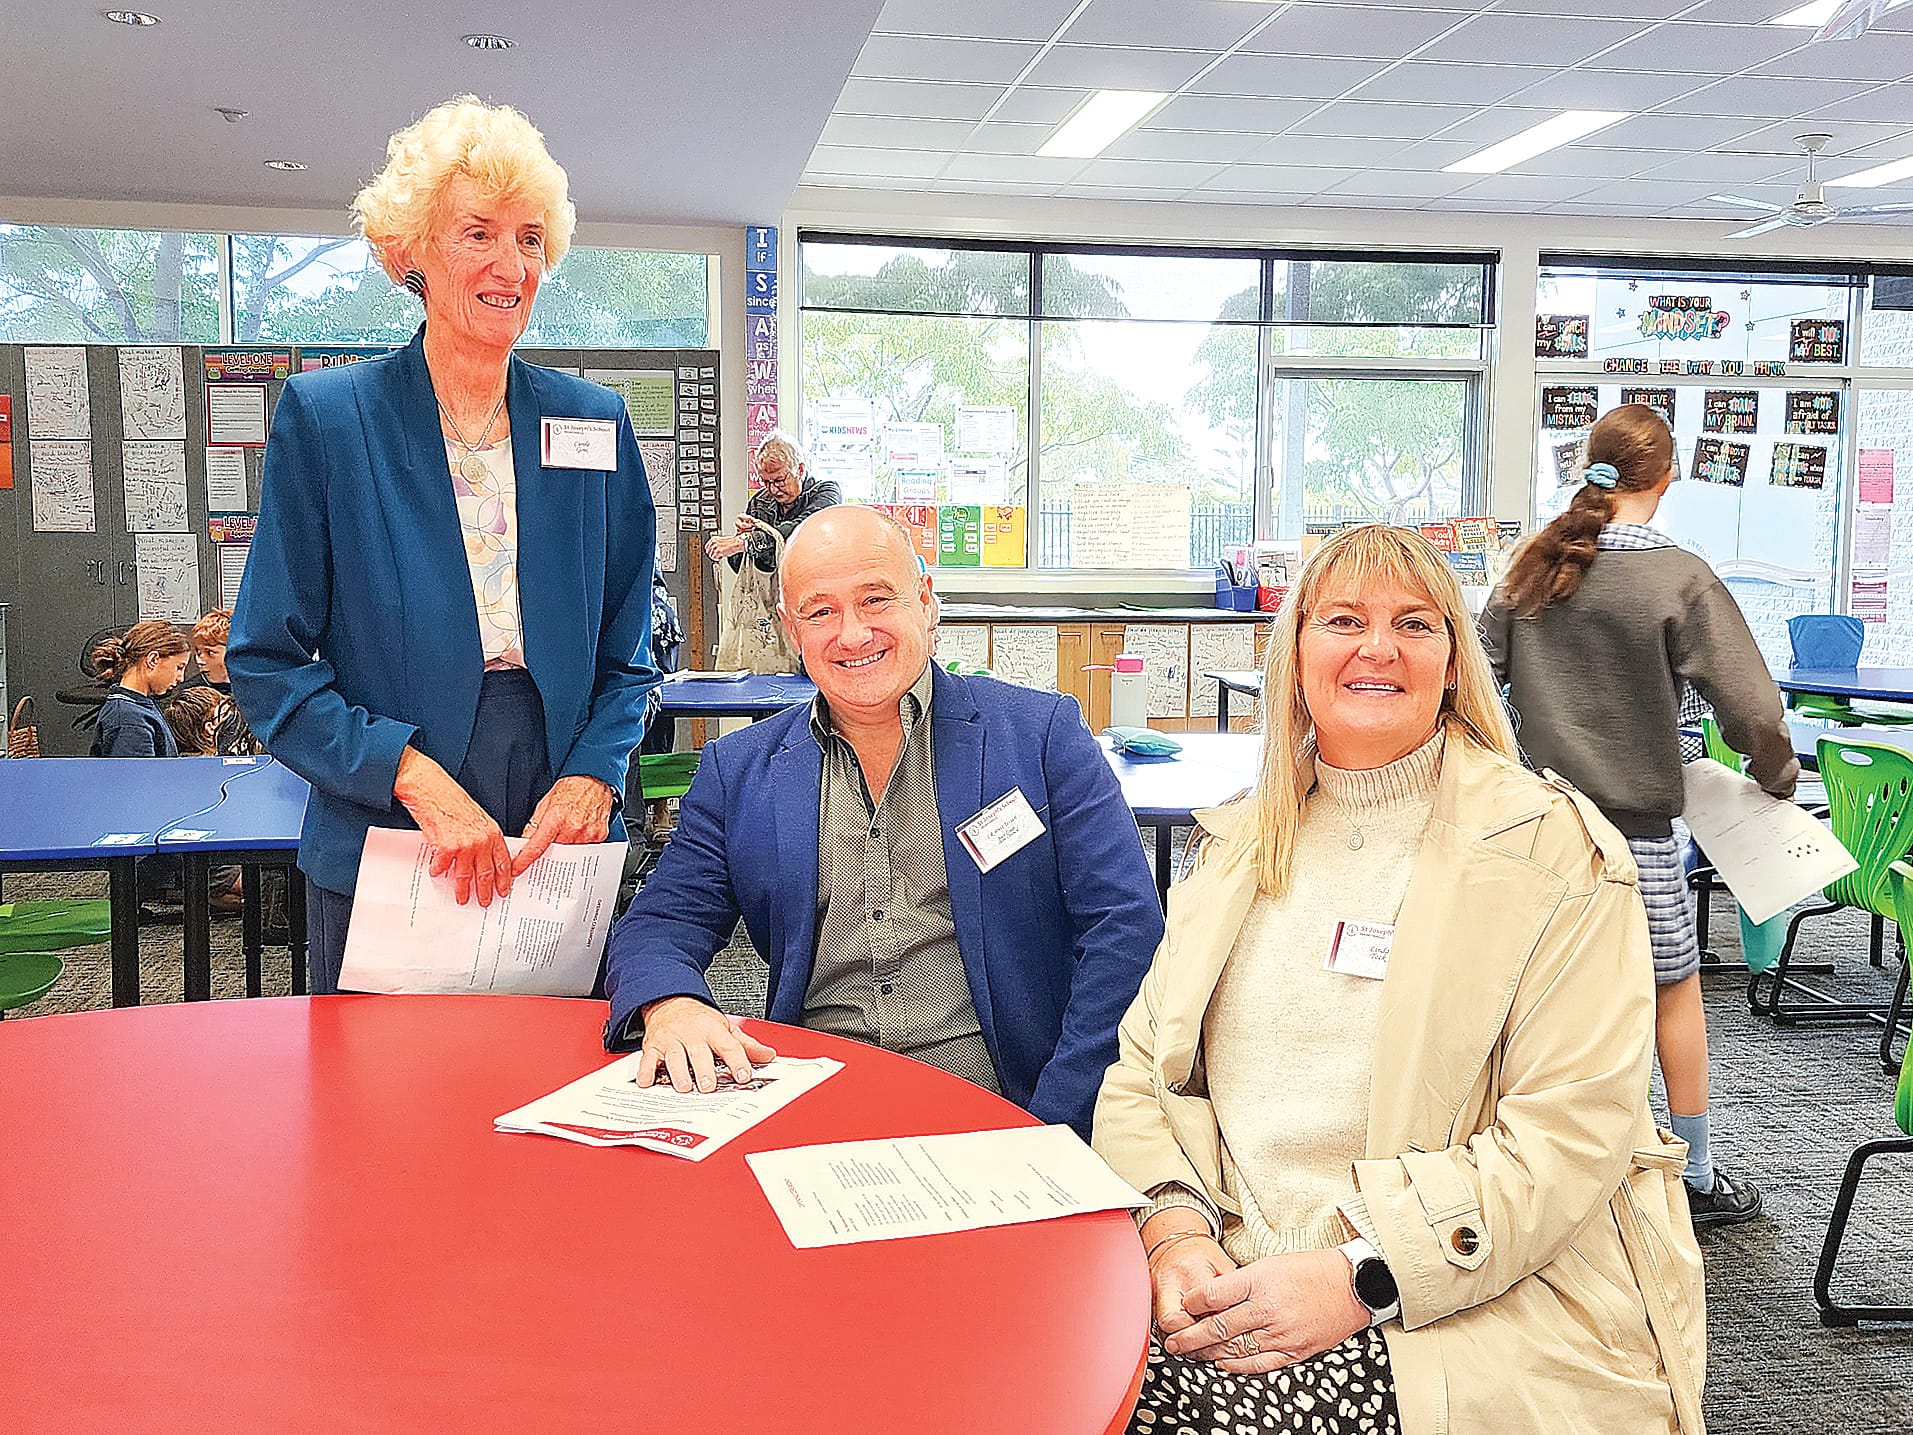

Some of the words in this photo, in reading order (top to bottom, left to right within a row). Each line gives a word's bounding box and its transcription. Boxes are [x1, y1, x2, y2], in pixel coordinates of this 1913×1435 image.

[756, 228, 768, 248] I
[756, 273, 768, 292] S
[747, 296, 777, 306] since
[1650, 296, 1676, 308] WHAT
[1677, 296, 1687, 308] IS
[1689, 296, 1711, 308] YOUR
[754, 317, 770, 337] A
[1542, 323, 1557, 331] can
[1642, 310, 1730, 338] MINDSET?
[1536, 340, 1551, 351] my
[222, 352, 250, 365] LEVEL
[252, 352, 273, 365] ONE
[753, 361, 772, 380] W
[1604, 357, 1649, 374] CHANGE
[1659, 359, 1682, 375] THE
[1687, 360, 1714, 375] WAY
[1721, 360, 1744, 375] YOU
[1754, 360, 1786, 376] THINK
[748, 384, 777, 395] when
[1553, 395, 1567, 403] can
[1634, 394, 1668, 406] BELIEVE
[1713, 399, 1727, 408] can
[1799, 400, 1812, 408] am
[755, 405, 770, 423] A
[1554, 403, 1574, 413] from
[1574, 406, 1587, 415] my
[1820, 409, 1833, 421] of
[1706, 414, 1723, 427] MY
[901, 477, 933, 487] Reading
[903, 487, 931, 496] Groups
[224, 515, 252, 529] LEVEL
